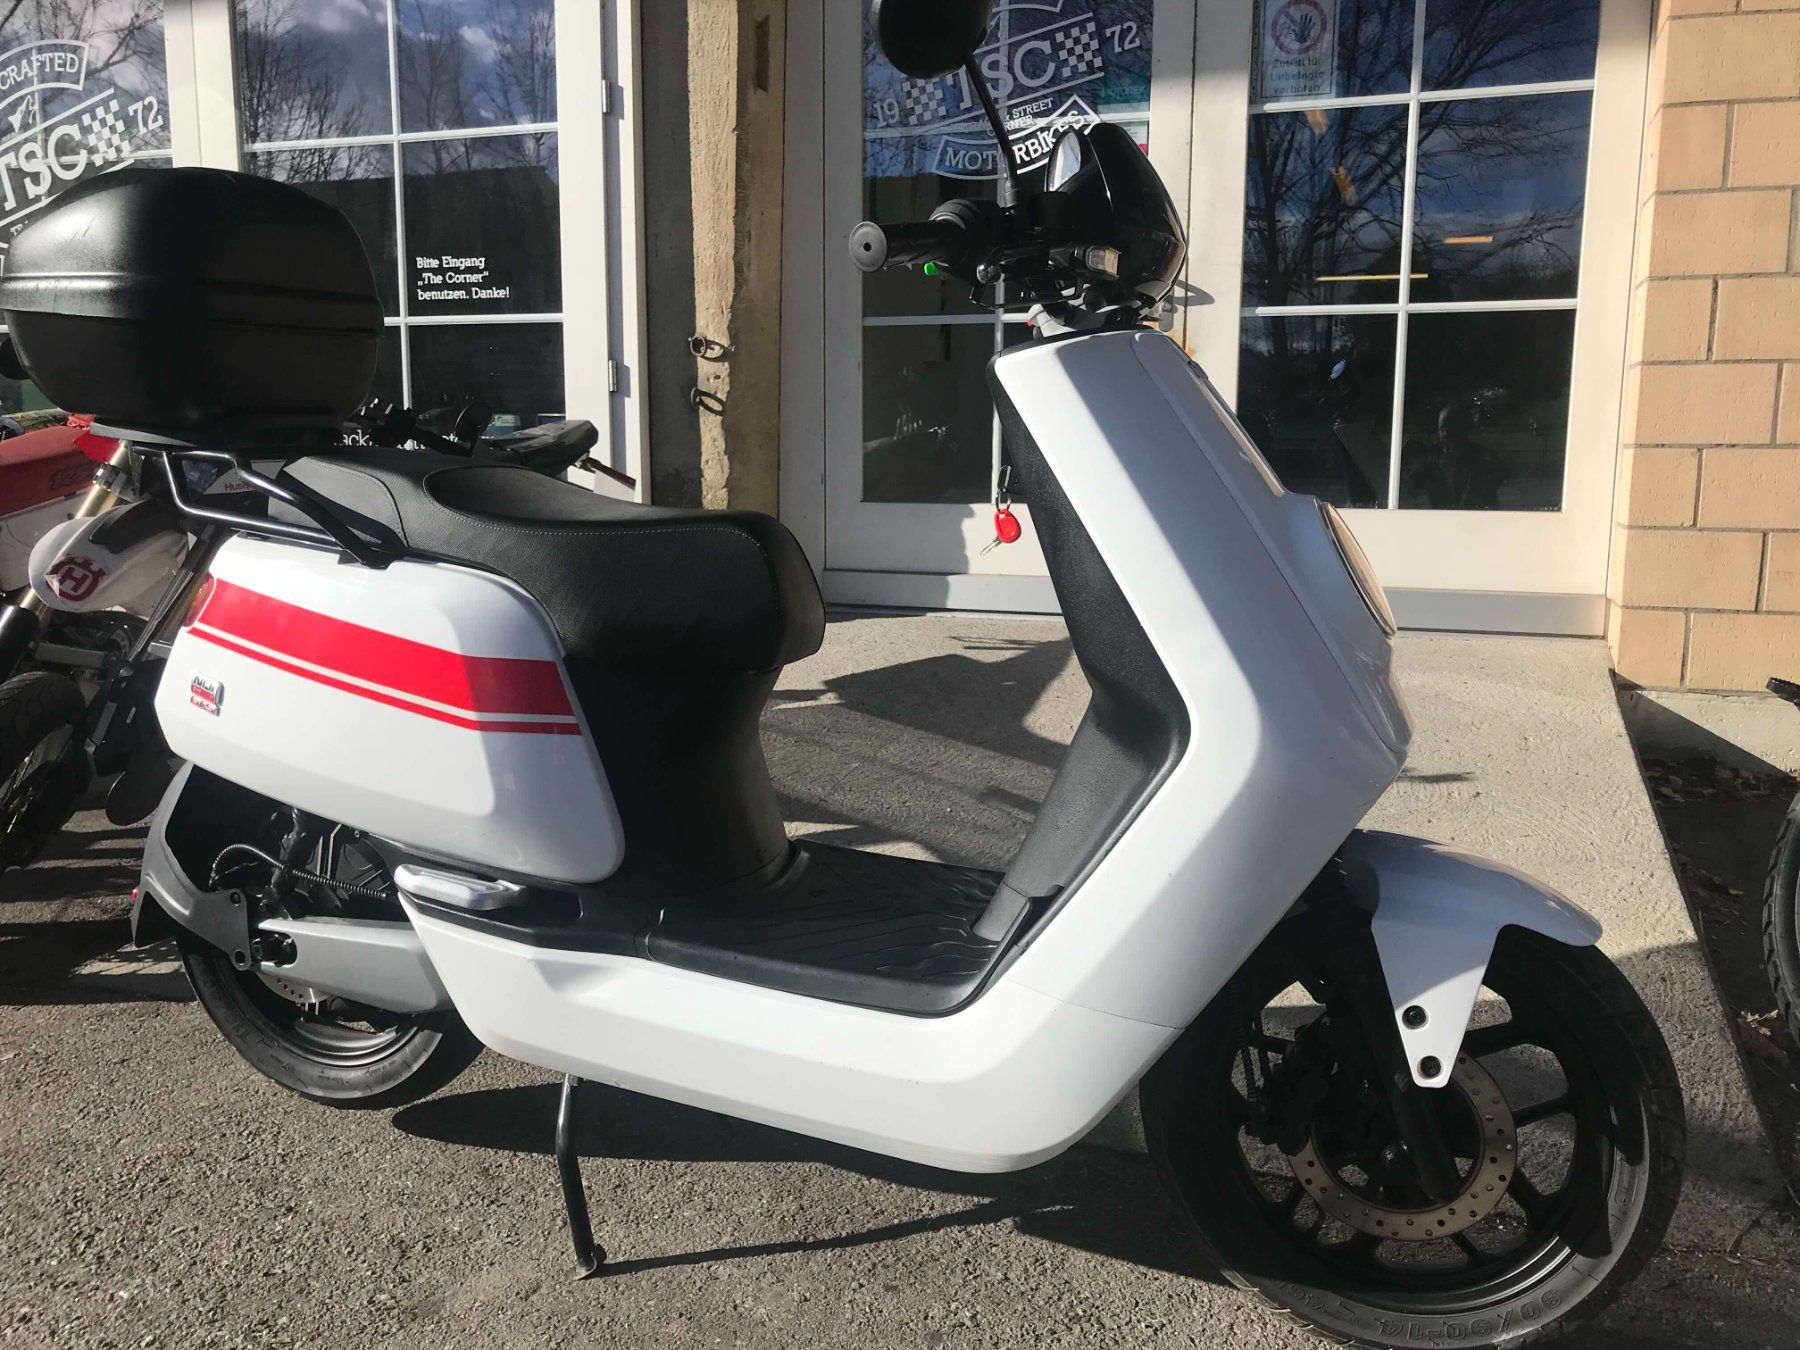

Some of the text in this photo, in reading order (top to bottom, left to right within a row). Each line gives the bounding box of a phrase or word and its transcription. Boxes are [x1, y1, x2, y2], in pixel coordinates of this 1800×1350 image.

[1106, 21, 1140, 54] 72
[0, 52, 79, 90] CRAFTED
[128, 96, 163, 135] 72
[873, 98, 900, 128] 19
[1012, 97, 1053, 118] STREET
[416, 255, 485, 270] Bitte Eingang
[417, 286, 510, 300] benutzen. Danke!
